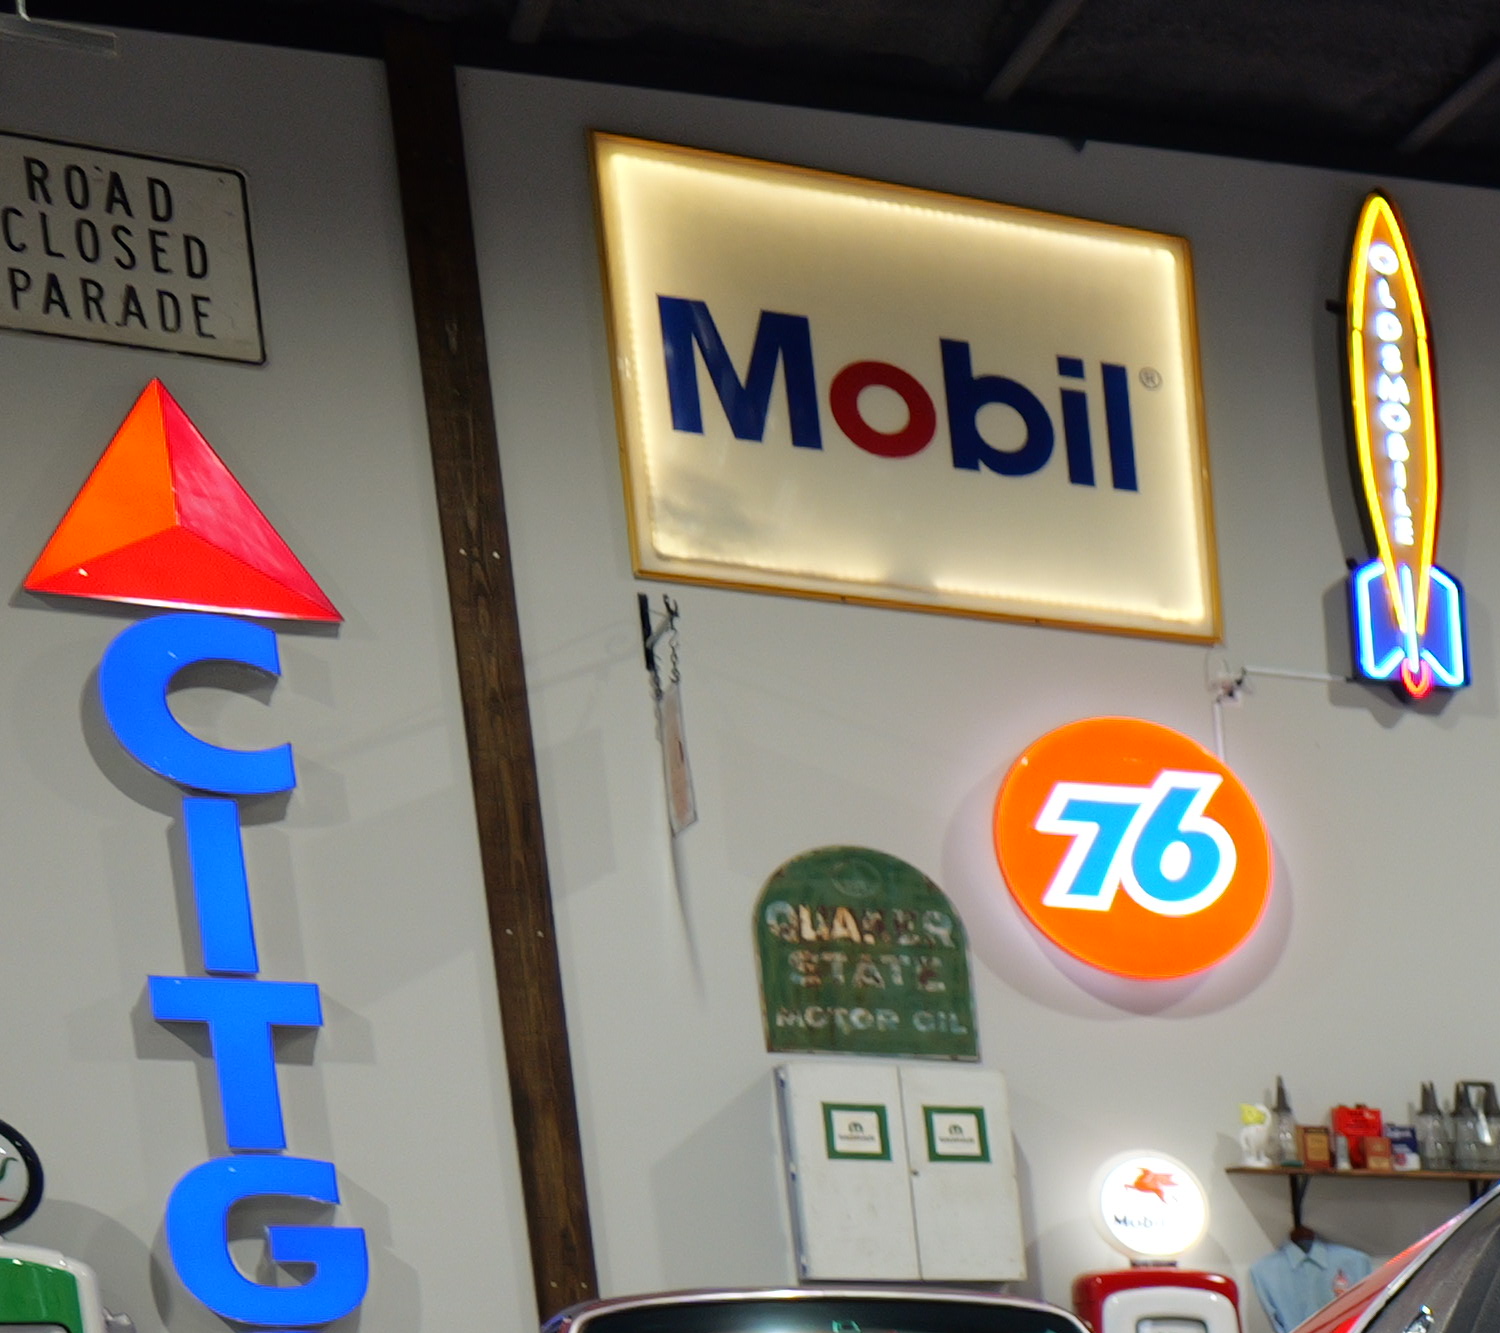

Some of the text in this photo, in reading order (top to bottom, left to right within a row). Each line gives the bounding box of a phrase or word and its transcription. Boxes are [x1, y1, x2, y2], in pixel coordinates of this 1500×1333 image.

[24, 156, 173, 222] ROAD
[1, 206, 208, 280] CLOSED
[8, 267, 216, 339] PARADE
[656, 292, 1140, 493] Mobil
[1034, 769, 1237, 918] 76
[788, 949, 946, 992] STATE
[775, 1005, 968, 1034] MOTOR OIL
